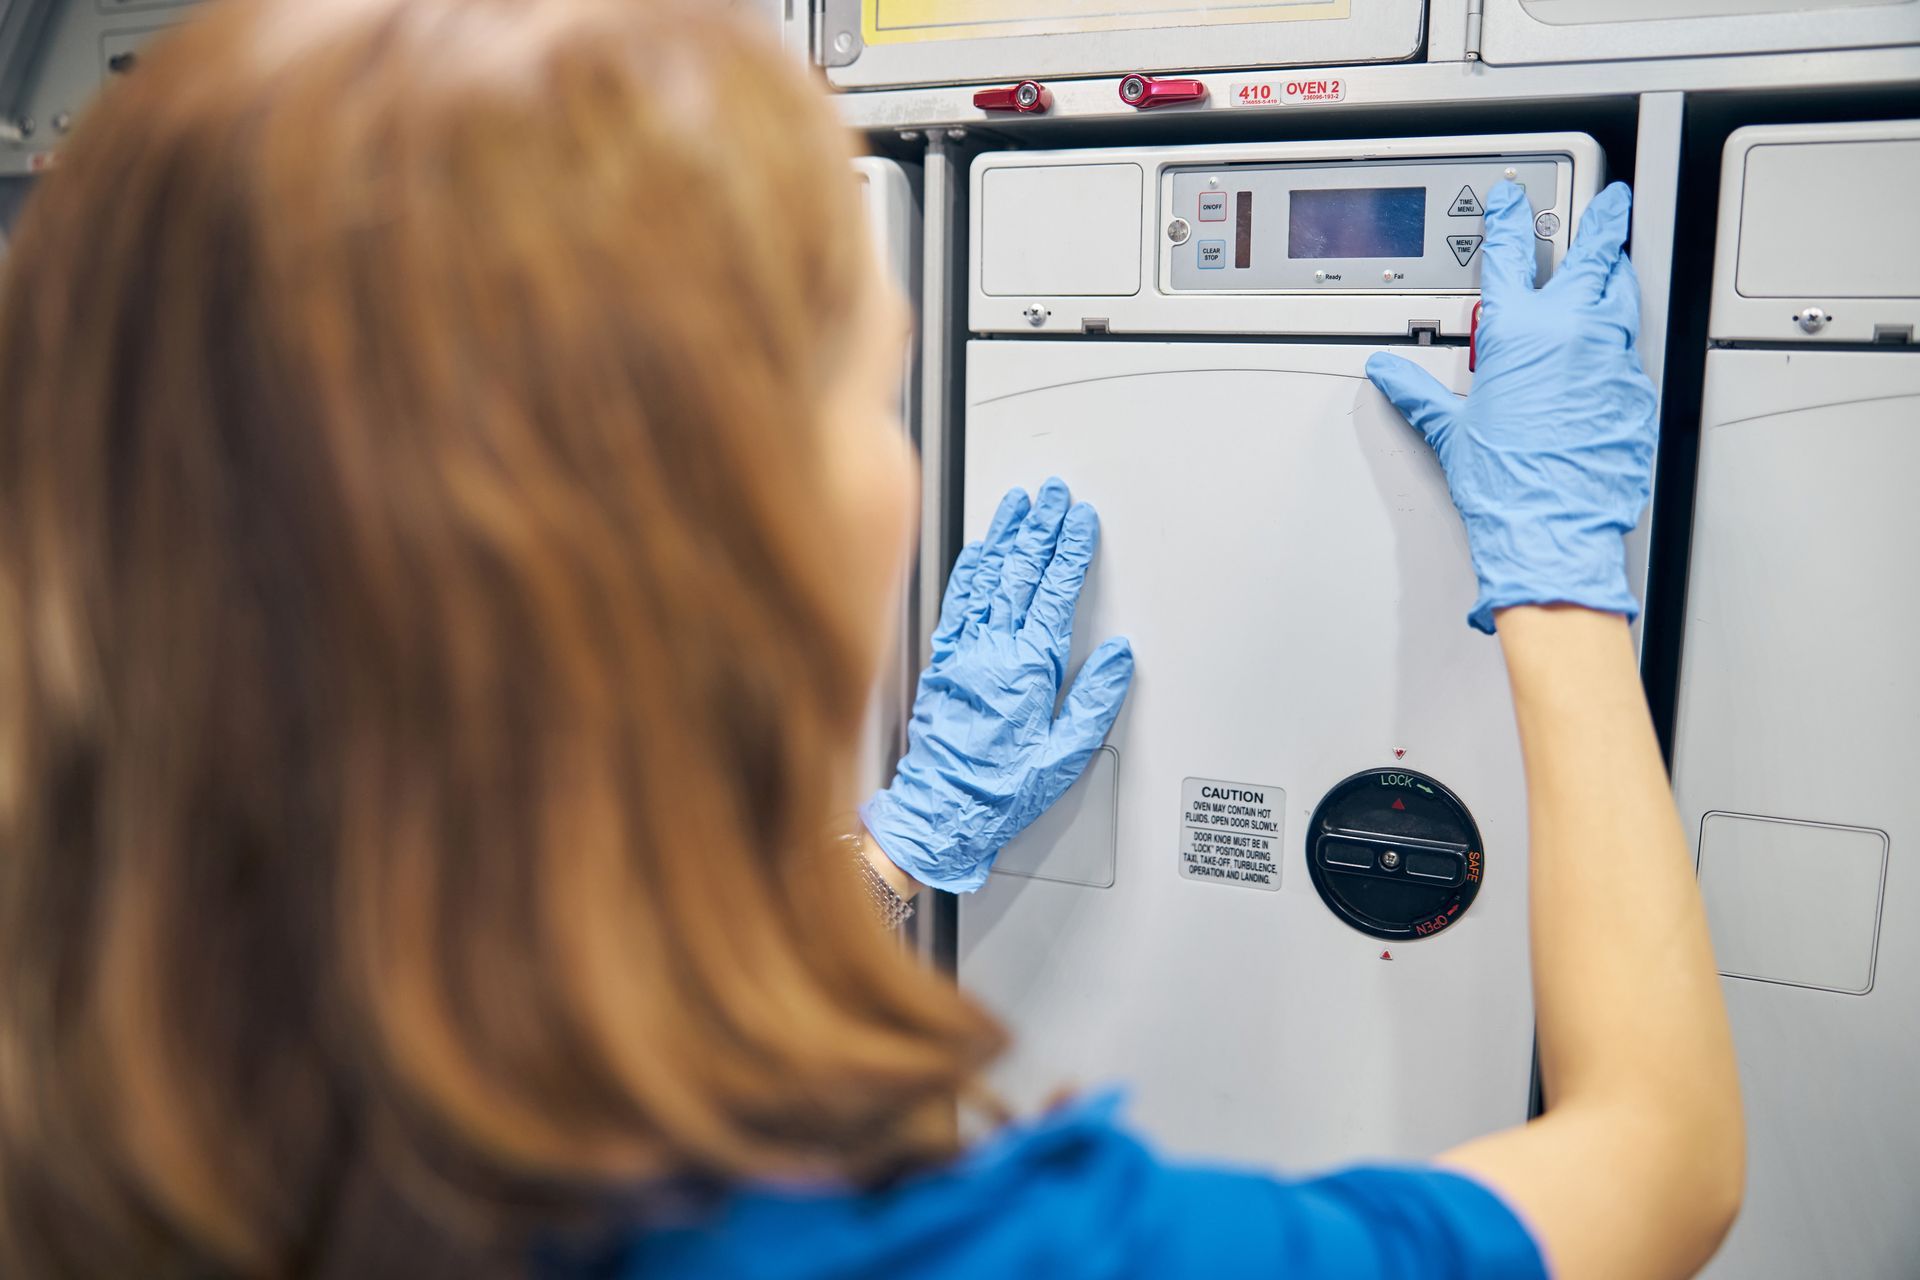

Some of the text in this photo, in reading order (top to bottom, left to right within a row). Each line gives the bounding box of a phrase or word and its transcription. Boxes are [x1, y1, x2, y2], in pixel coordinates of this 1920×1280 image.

[1239, 85, 1271, 99] 410
[1286, 80, 1340, 95] OVEN 2
[1325, 273, 1342, 281] Ready
[1380, 774, 1414, 788] LOCK
[1201, 786, 1264, 804] CAUTION
[1193, 800, 1271, 819] OVEN MAY CONTAIN HOT
[1185, 811, 1278, 832] FLUIDS. OPEN DOOR SLOWLY.
[1193, 831, 1269, 849] DOOR KNOB MUST BE IN
[1215, 845, 1245, 858] POSITION
[1246, 849, 1271, 861] DURING
[1188, 864, 1271, 884] OPERATION AND LANDING.
[1234, 859, 1278, 875] TURBULENCE,
[1466, 851, 1480, 883] SAFE
[1415, 914, 1448, 936] OPEN
